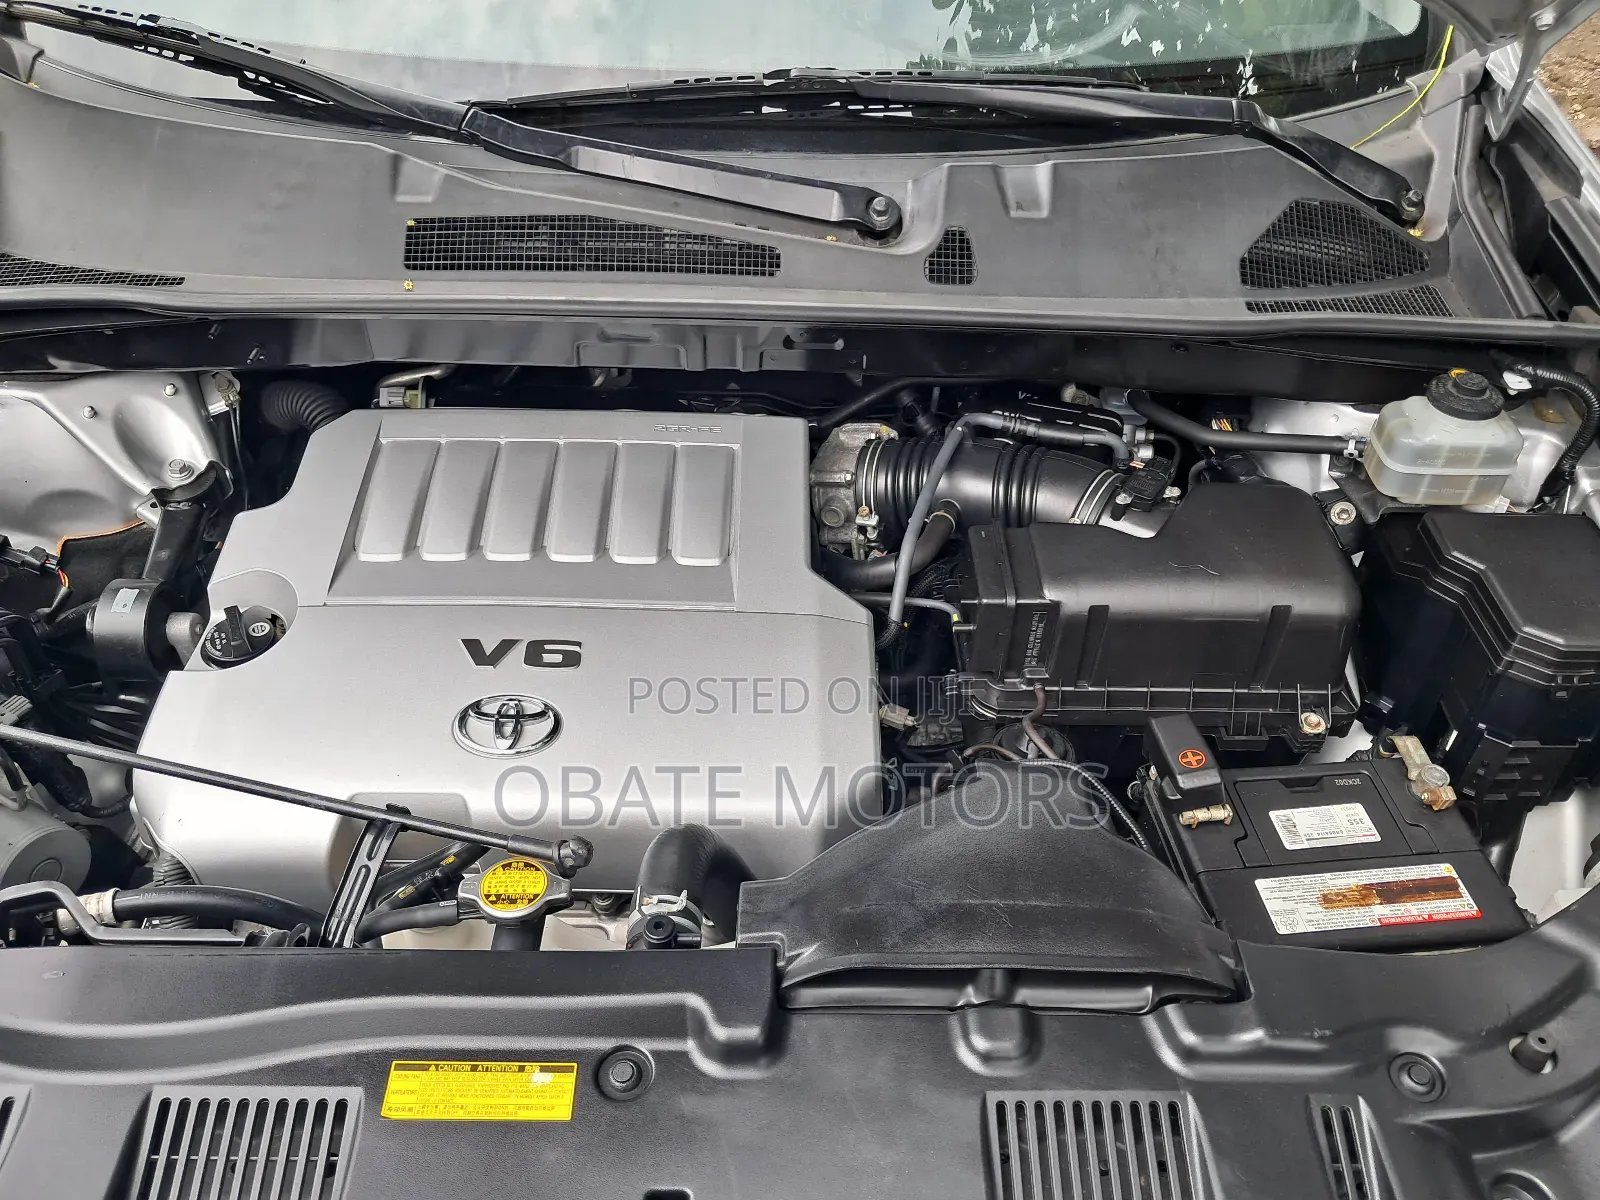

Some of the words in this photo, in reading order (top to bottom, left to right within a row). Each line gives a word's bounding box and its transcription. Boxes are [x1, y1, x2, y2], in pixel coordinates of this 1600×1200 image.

[458, 638, 583, 669] V6
[438, 1064, 472, 1072] CAUTION
[477, 1064, 519, 1072] ATTENTION
